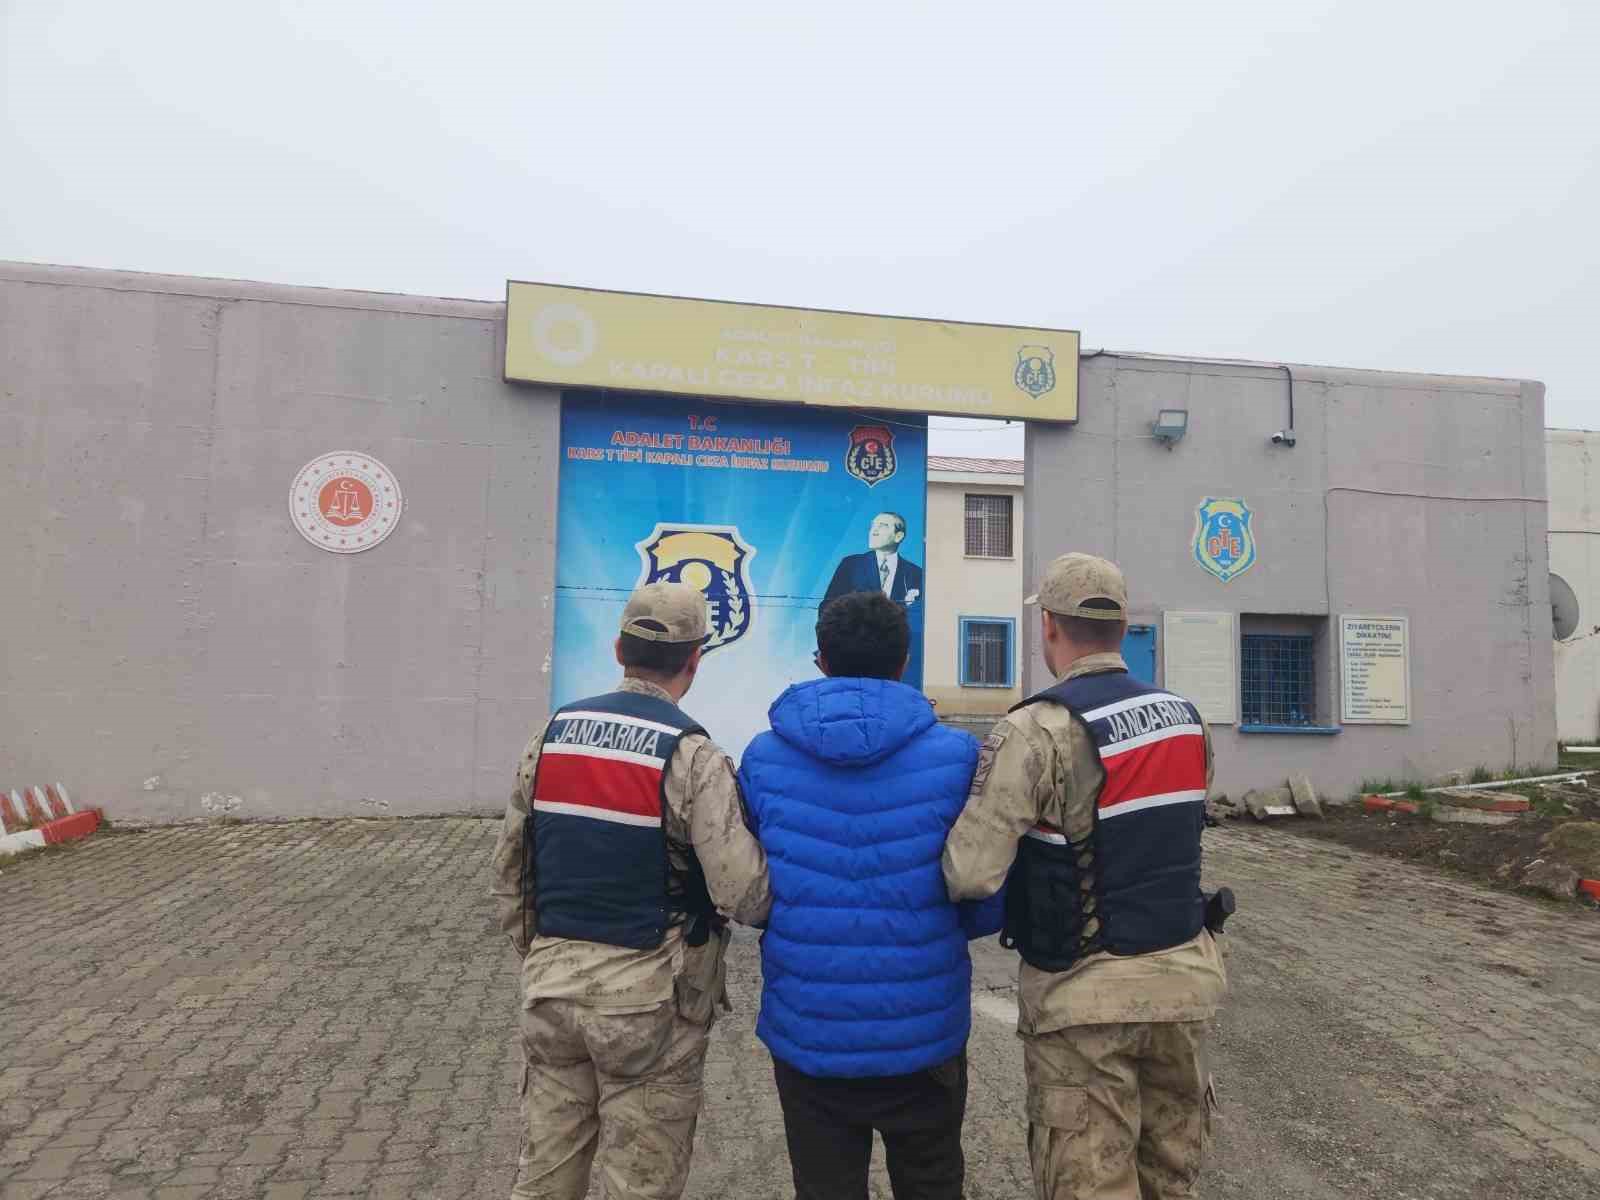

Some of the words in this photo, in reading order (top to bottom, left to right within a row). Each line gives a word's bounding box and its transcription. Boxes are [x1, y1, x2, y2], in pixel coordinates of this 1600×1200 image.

[610, 430, 682, 449] ADALET
[687, 435, 791, 456] BAKANLIĞI
[646, 451, 693, 466] KAPALI
[1106, 700, 1196, 743] JANDARMA
[555, 719, 661, 756] JANDARMA
